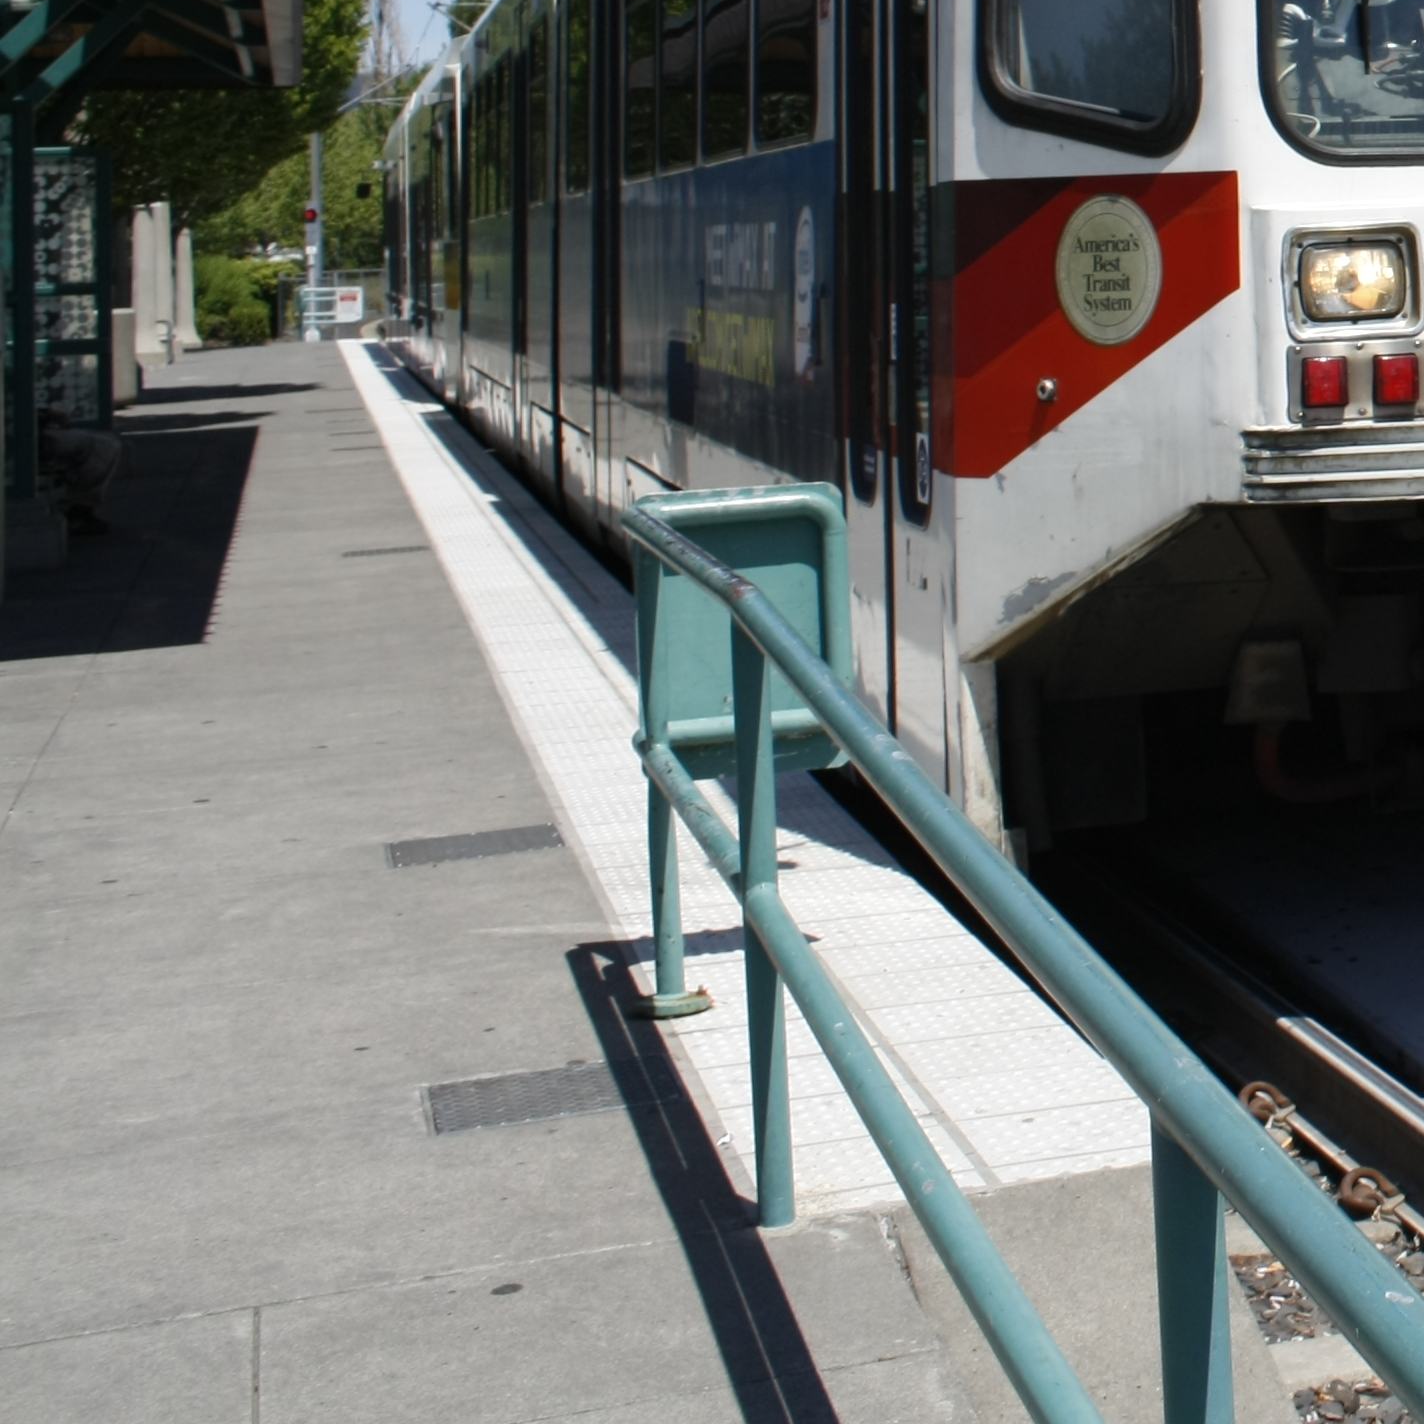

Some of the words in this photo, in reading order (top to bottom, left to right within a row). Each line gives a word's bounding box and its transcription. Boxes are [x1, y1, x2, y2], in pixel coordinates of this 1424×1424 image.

[1073, 232, 1140, 254] America's
[1092, 253, 1121, 273] Best
[1082, 272, 1131, 293] Transit
[1083, 293, 1132, 317] System
